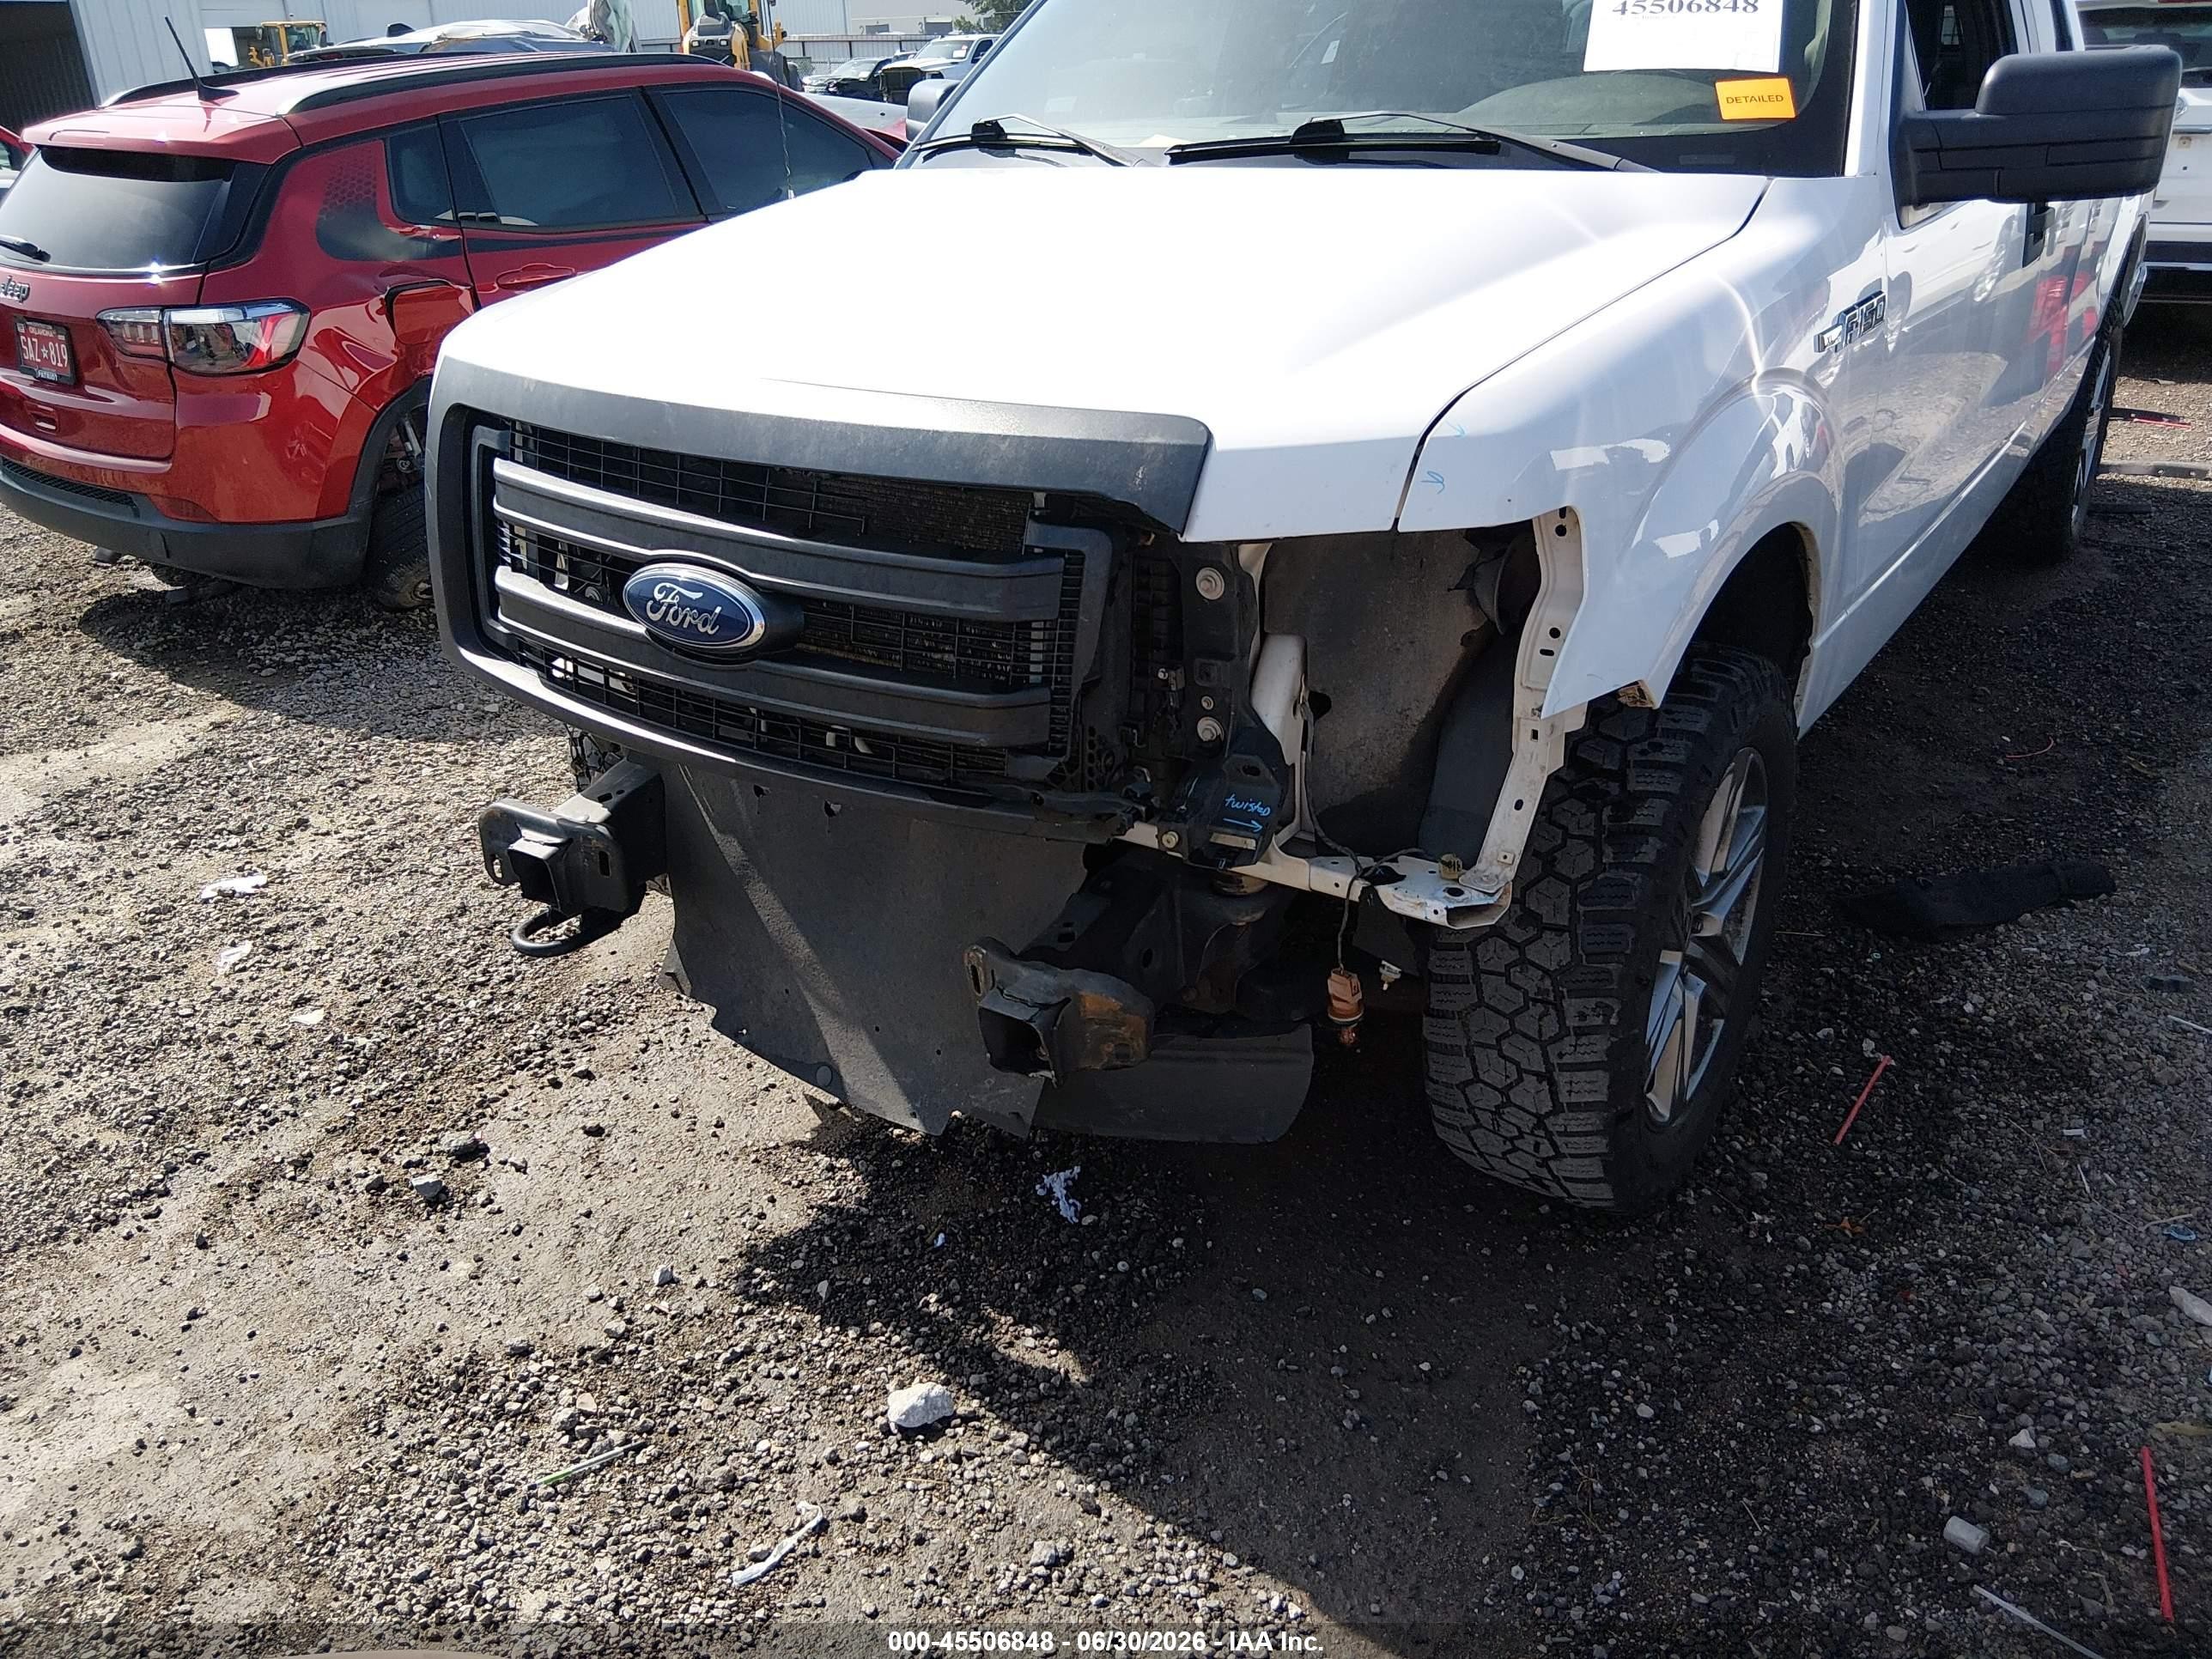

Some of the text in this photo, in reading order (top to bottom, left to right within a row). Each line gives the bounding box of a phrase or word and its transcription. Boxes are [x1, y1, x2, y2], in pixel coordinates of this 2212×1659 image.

[1611, 0, 1759, 15] 45506848
[1725, 94, 1784, 105] DETAILED
[20, 335, 68, 368] SAZ 819
[646, 581, 722, 635] Ford
